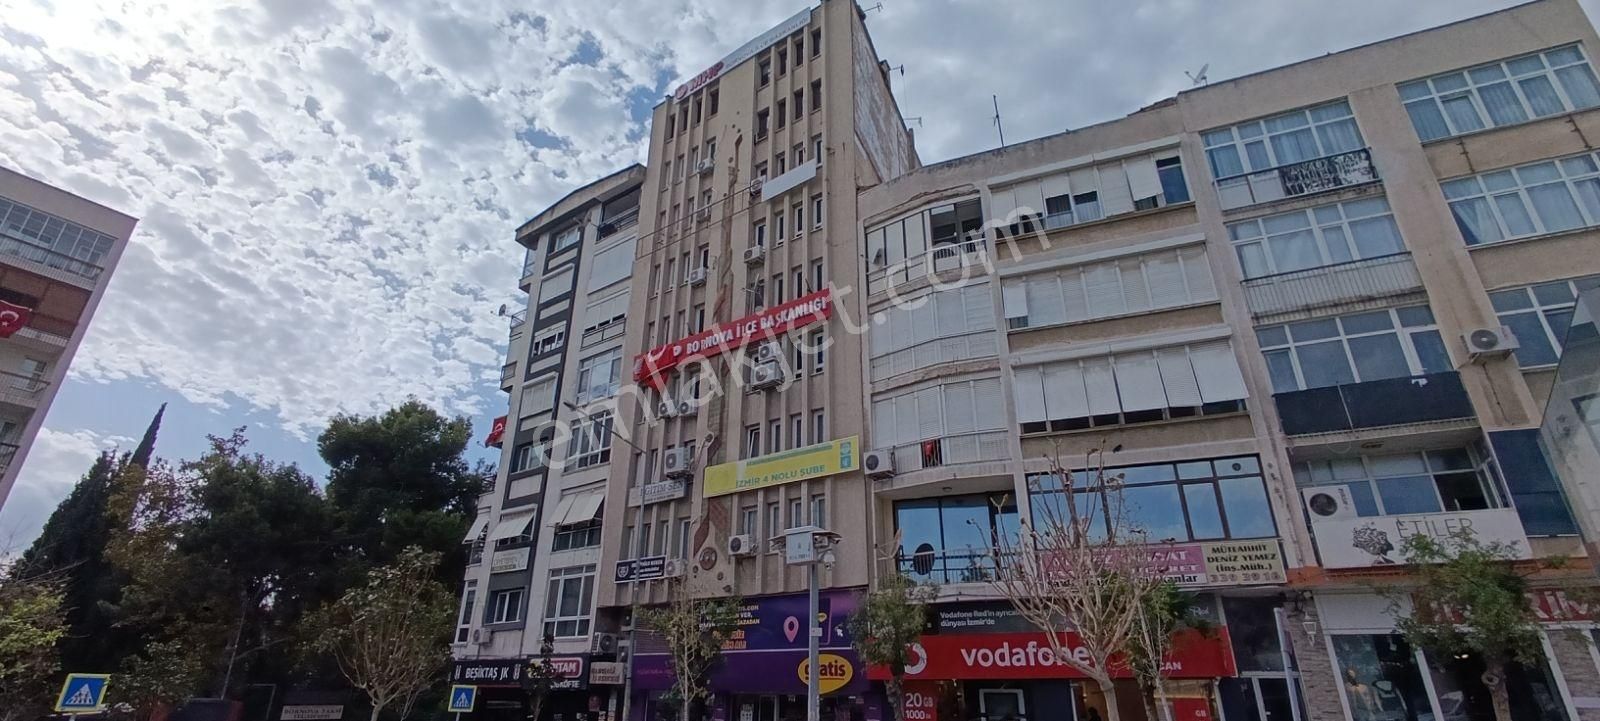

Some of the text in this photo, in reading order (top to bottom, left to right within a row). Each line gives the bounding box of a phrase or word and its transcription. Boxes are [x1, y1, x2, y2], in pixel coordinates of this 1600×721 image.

[1206, 552, 1278, 563] DENİZ YEMEZ
[939, 611, 973, 620] Vodafone
[465, 665, 499, 681] BEŞİKTAŞ
[905, 692, 922, 708] 20
[905, 709, 925, 720] 1000
